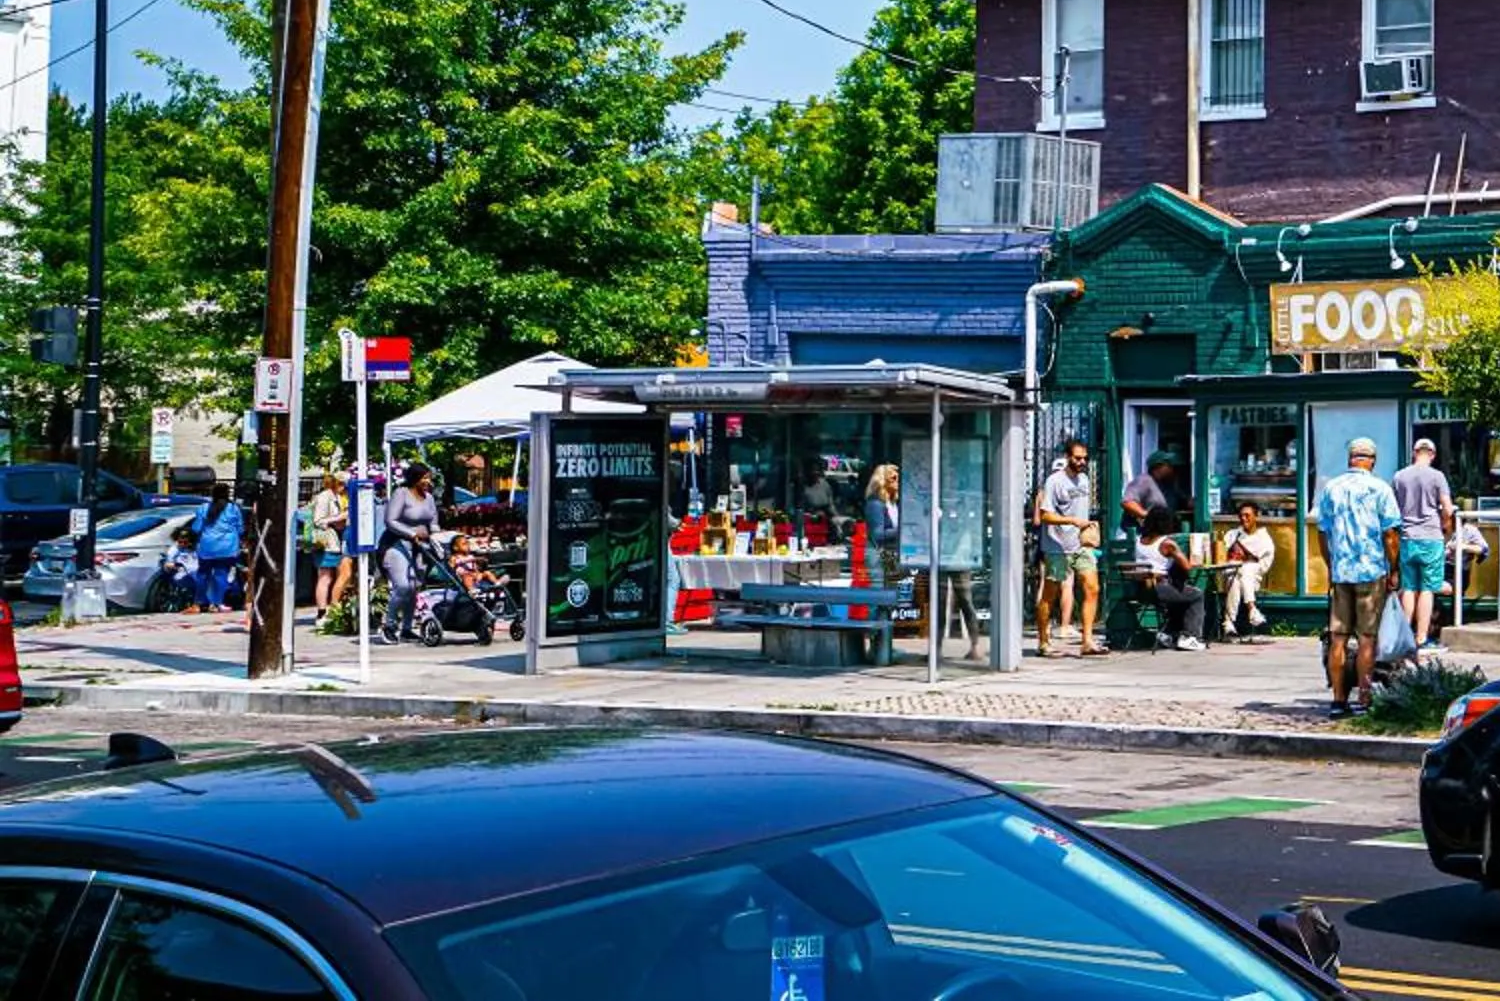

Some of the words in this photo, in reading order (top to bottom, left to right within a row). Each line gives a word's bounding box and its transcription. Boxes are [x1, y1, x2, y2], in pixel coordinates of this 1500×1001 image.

[1290, 287, 1425, 343] FOOD
[1221, 406, 1288, 424] PASTRIES
[555, 458, 600, 478] ZERO
